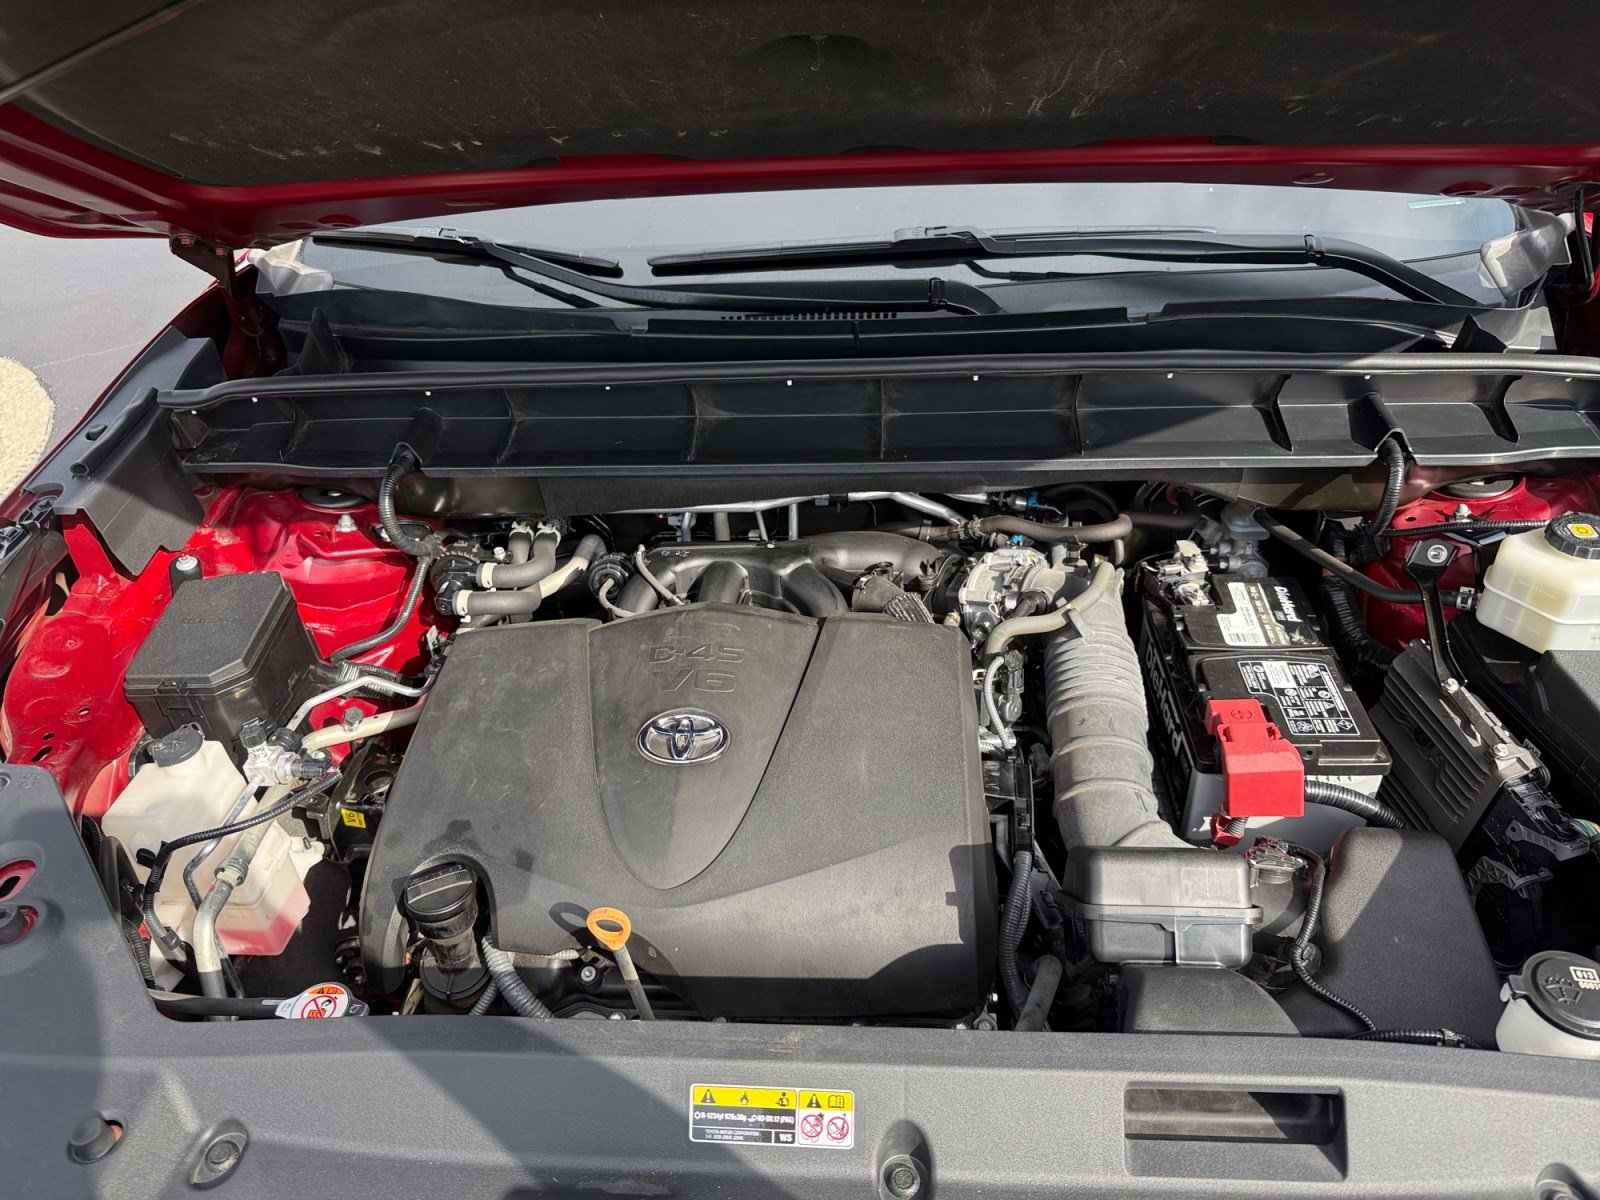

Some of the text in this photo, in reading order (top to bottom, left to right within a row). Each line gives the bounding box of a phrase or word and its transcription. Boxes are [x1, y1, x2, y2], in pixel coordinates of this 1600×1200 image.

[1274, 586, 1304, 622] DieHard
[651, 668, 736, 693] V6
[1146, 641, 1182, 758] DieHard
[779, 1133, 793, 1142] WS
